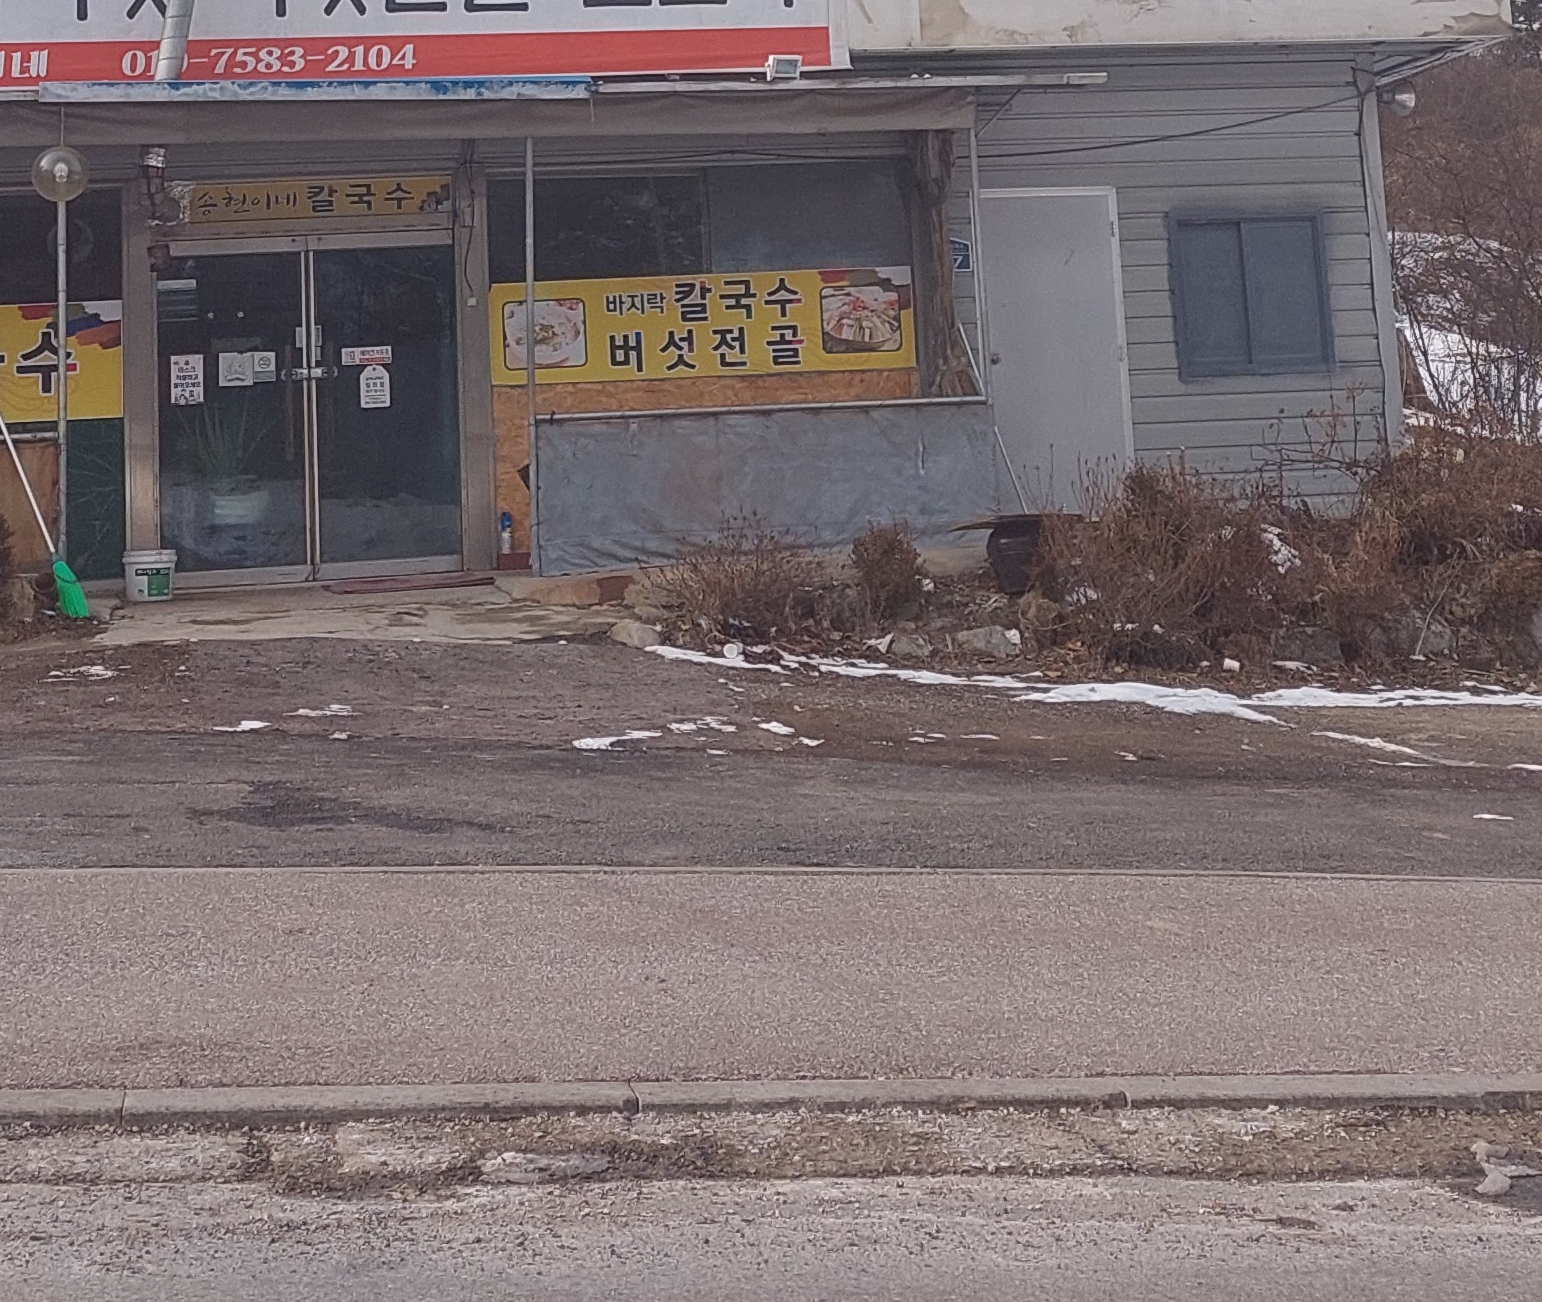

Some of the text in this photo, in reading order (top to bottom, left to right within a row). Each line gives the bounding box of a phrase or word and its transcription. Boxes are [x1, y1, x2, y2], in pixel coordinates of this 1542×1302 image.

[121, 43, 417, 77] 01-7583-2104
[196, 182, 414, 217] 송현이네 칼국수
[605, 278, 802, 322] 바지락 칼국수
[609, 324, 804, 372] 버섯전골
